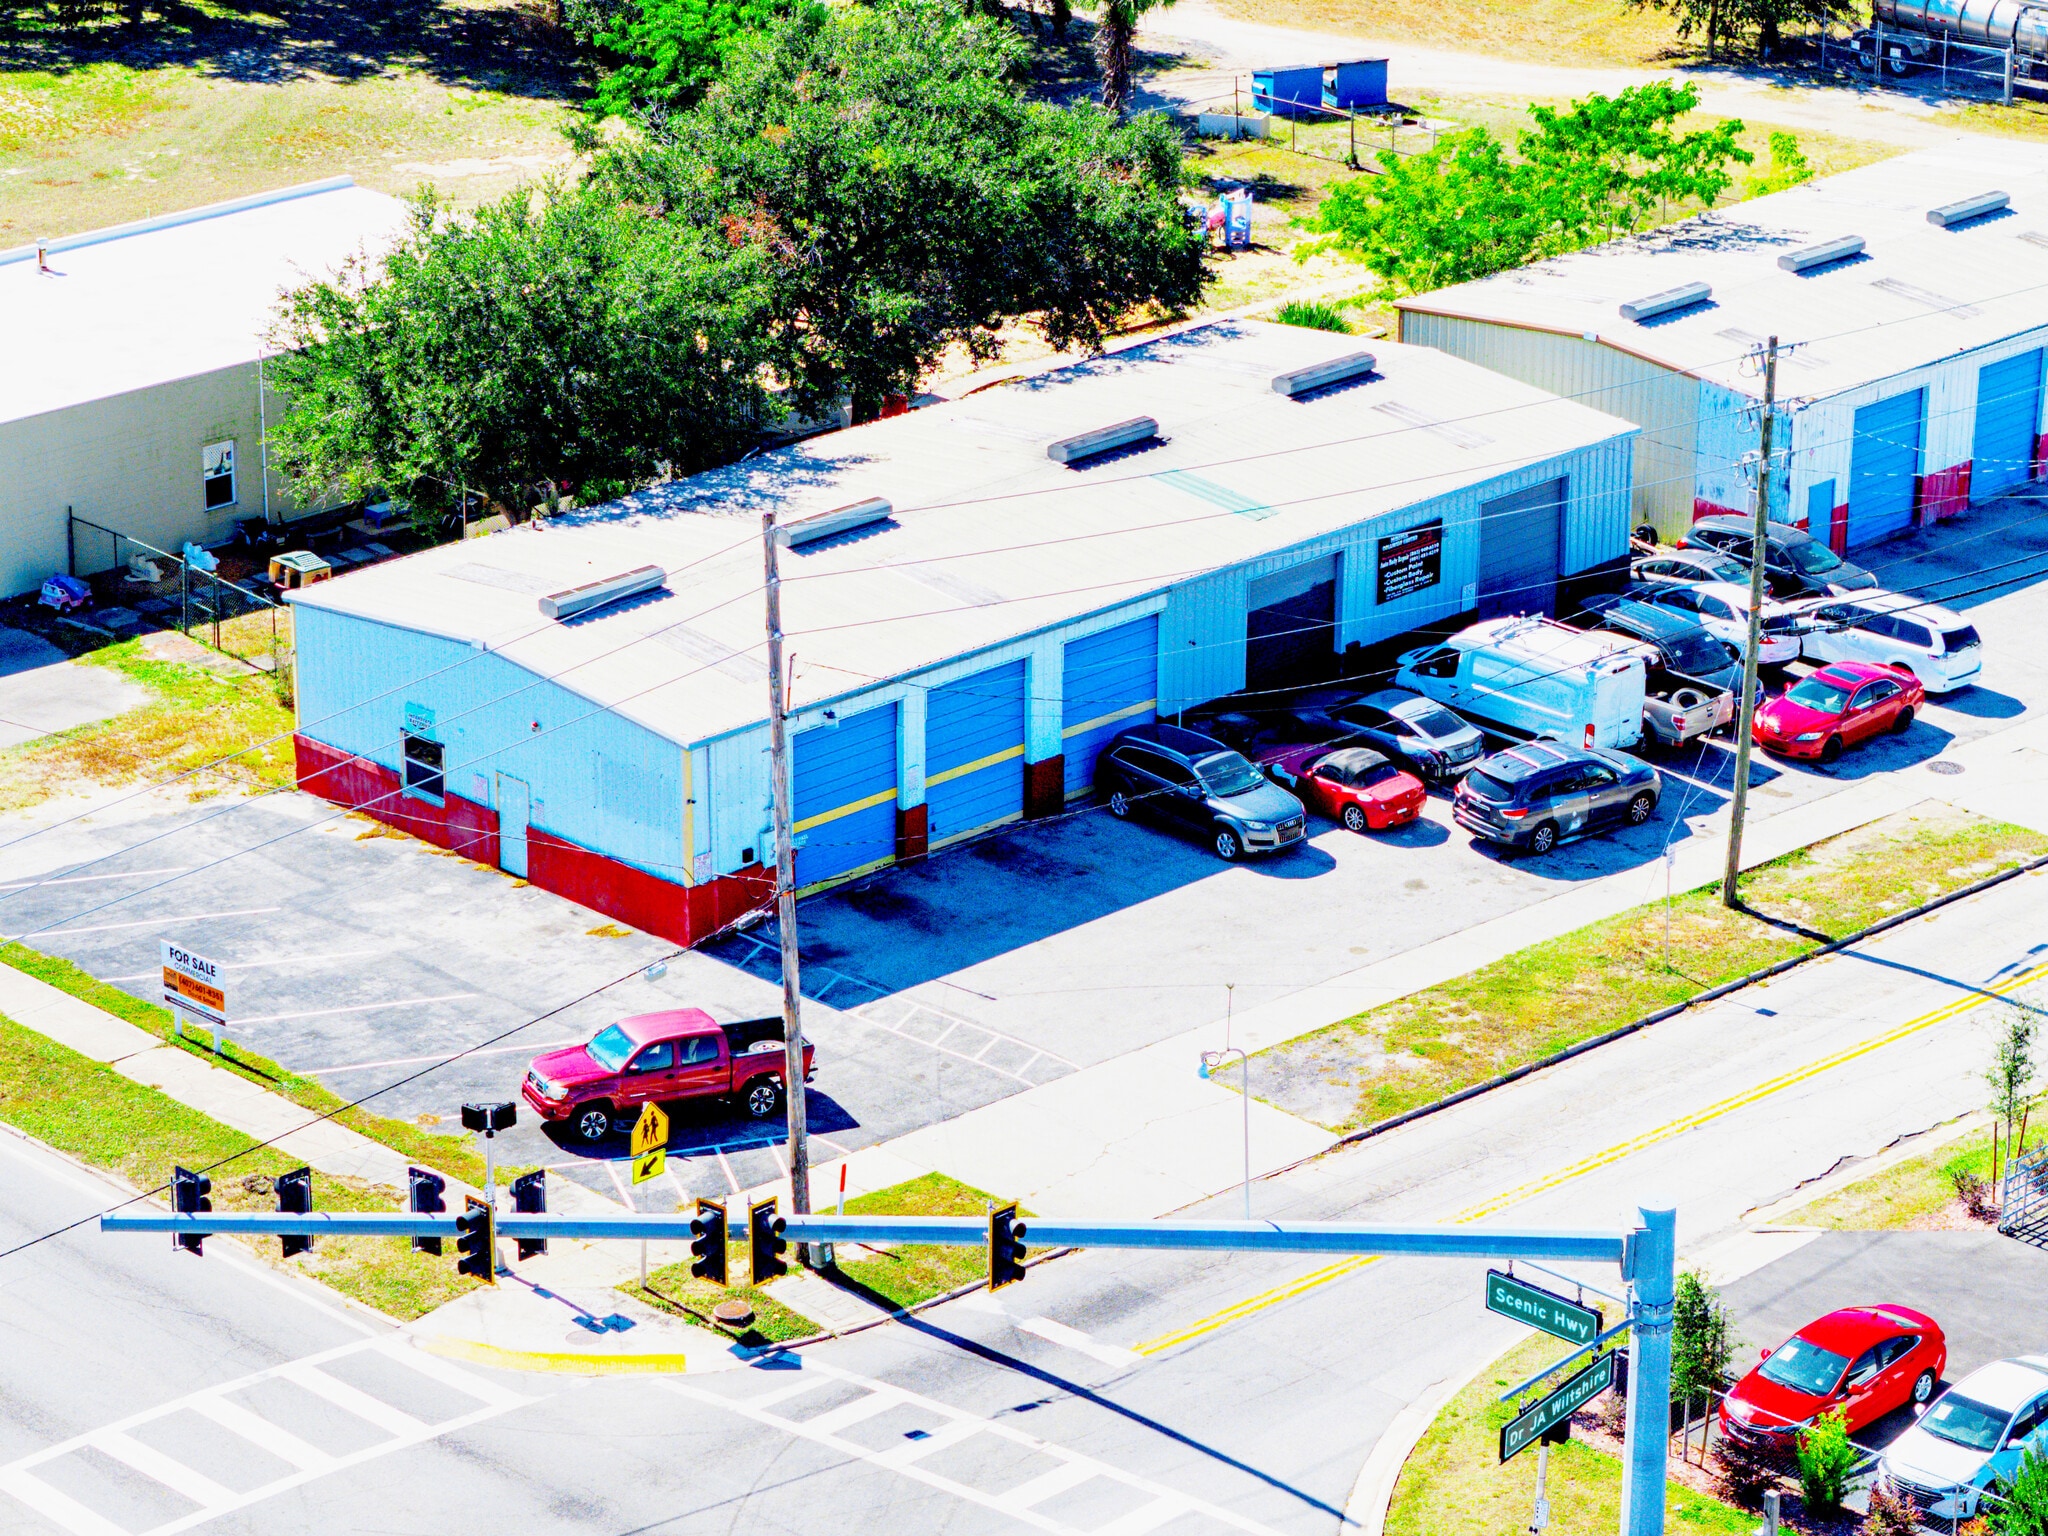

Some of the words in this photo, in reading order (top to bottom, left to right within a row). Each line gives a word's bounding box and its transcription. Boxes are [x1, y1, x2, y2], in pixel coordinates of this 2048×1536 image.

[1408, 560, 1424, 570] Paint
[1408, 569, 1424, 578] Body
[1415, 572, 1434, 582] Repair
[169, 946, 190, 966] FOR
[192, 957, 217, 978] SALE
[174, 962, 213, 985] COMMERCIAL
[1496, 1286, 1547, 1319] Scenic
[1554, 1309, 1589, 1339] Hwy
[1509, 1427, 1525, 1447] Dr
[1529, 1410, 1546, 1432] JA
[1551, 1368, 1606, 1417] Wiltshire
